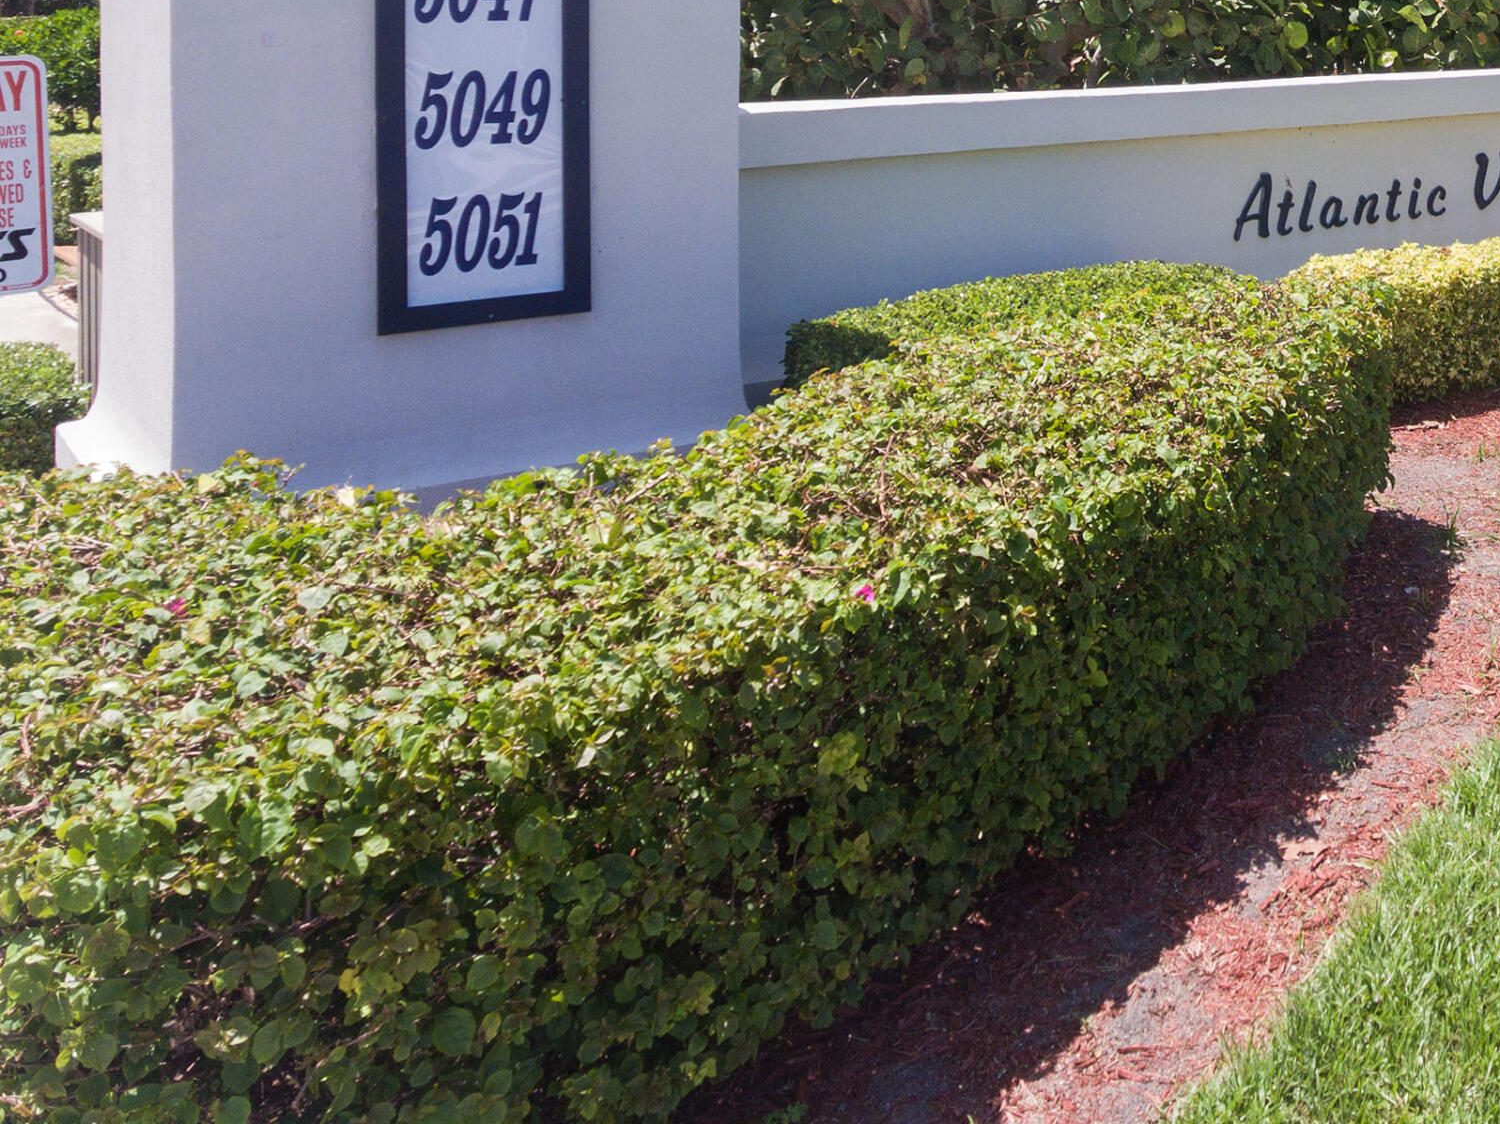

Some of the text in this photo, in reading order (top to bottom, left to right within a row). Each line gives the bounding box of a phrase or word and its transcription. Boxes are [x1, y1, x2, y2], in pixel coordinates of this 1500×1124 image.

[413, 68, 551, 150] 5049
[418, 191, 543, 277] 5051
[1232, 171, 1447, 242] Atlantic
